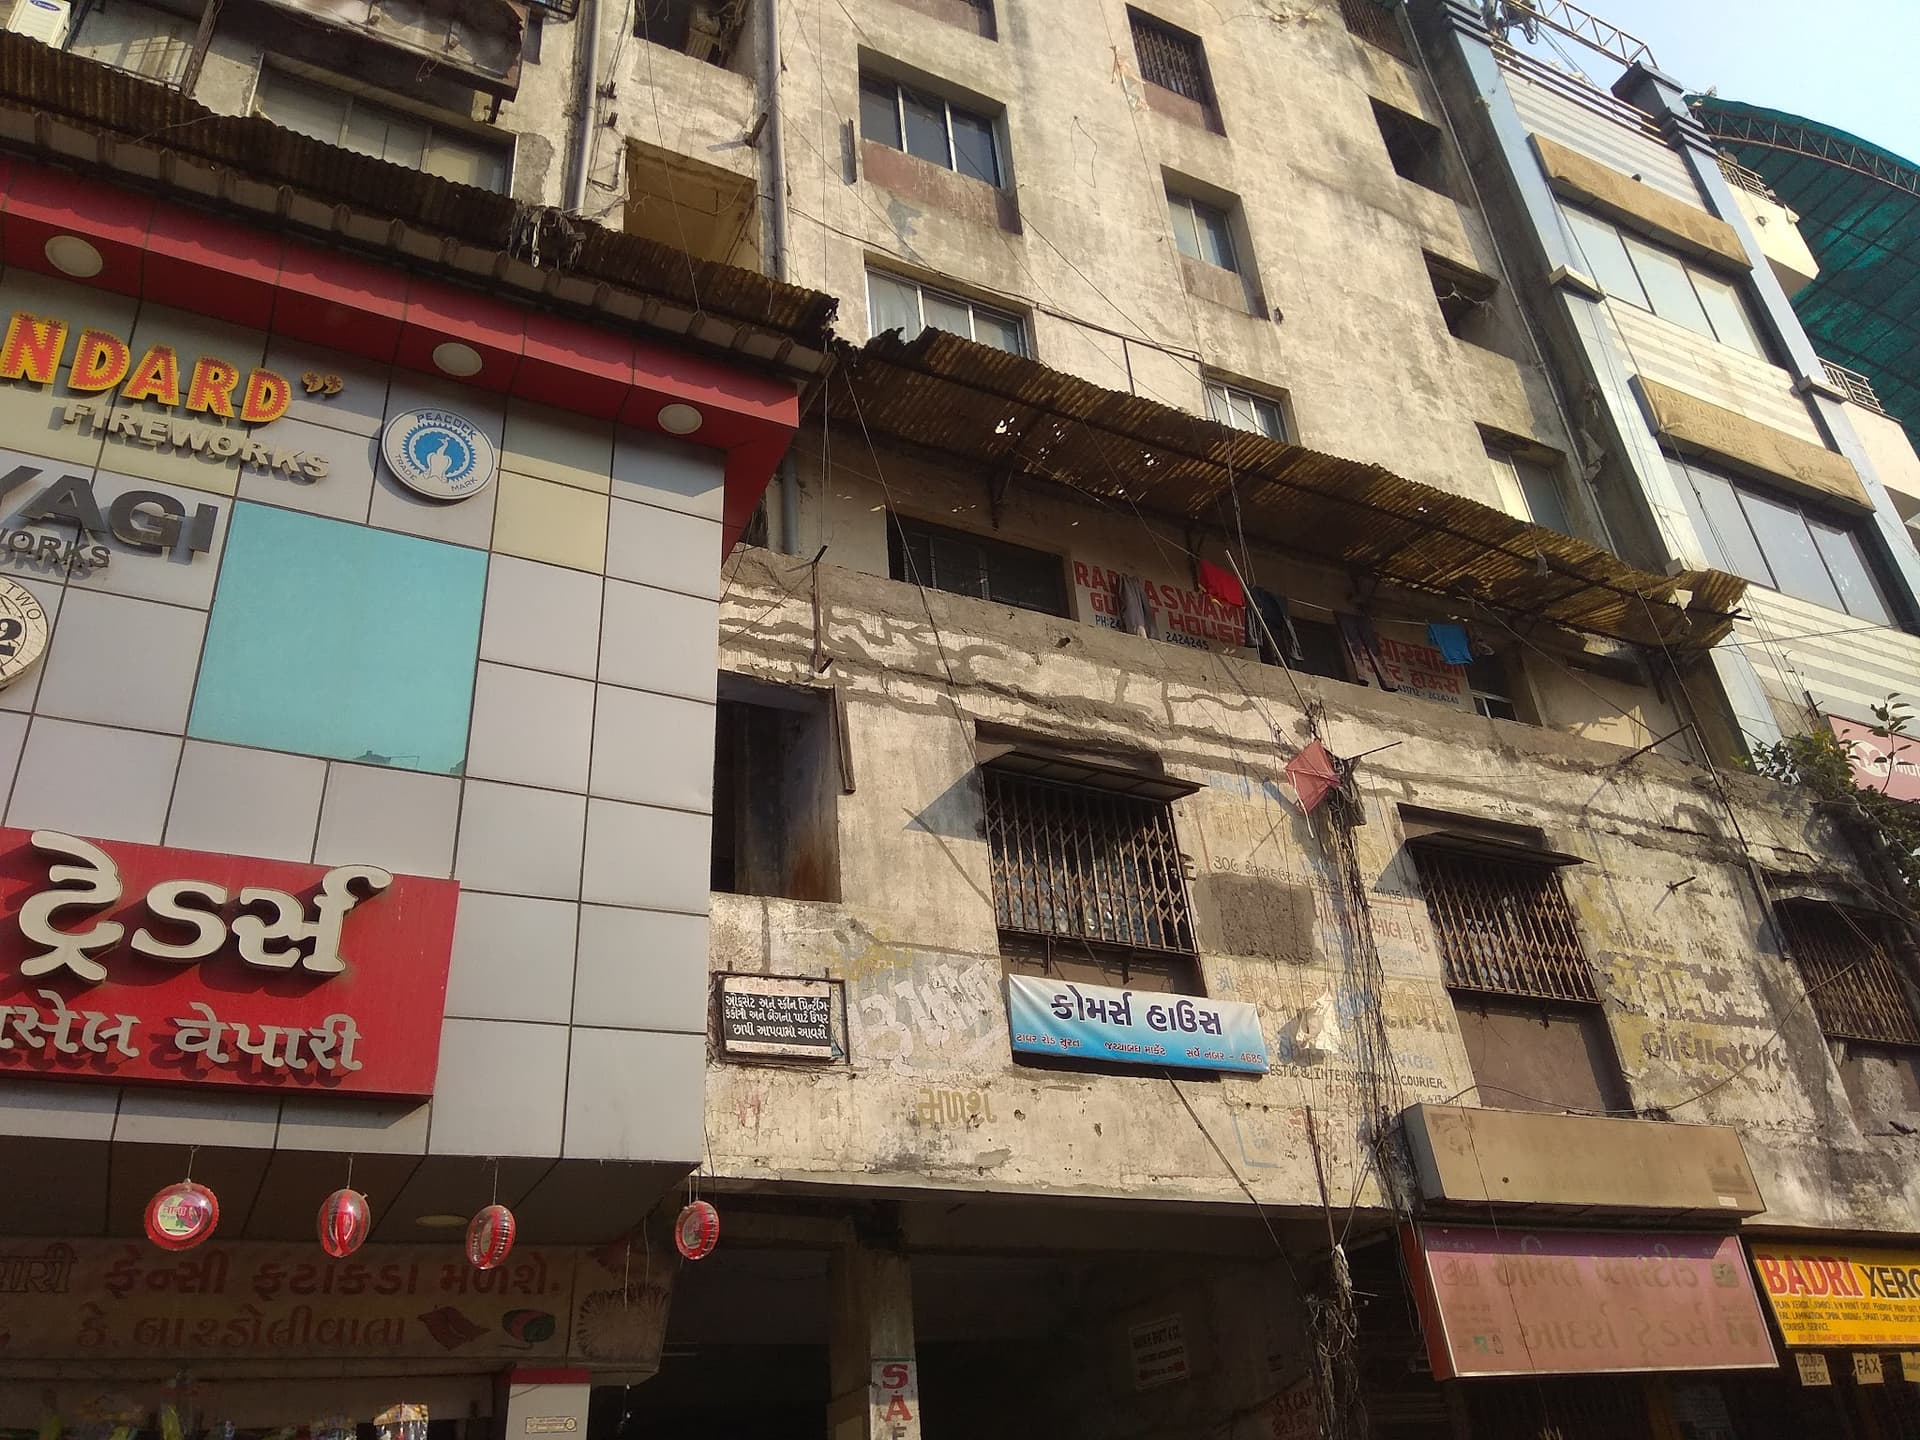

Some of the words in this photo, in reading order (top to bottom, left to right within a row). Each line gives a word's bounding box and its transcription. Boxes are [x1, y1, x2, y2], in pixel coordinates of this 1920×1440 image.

[63, 399, 329, 478] FIREWORKS
[417, 411, 478, 441] PEACOCK
[395, 453, 418, 481] TRADE
[450, 476, 478, 491] MARK
[6, 582, 42, 621] TWO
[1073, 559, 1246, 629] RADASWAMI
[1089, 591, 1160, 623] GUT
[1168, 614, 1246, 648] HOUSE
[18, 829, 394, 982] ટ્રેડર્સ
[748, 1007, 767, 1022] અને
[759, 996, 777, 1010] અને
[1050, 984, 1133, 1027] કોમર્સ
[1146, 1000, 1223, 1036] હાઉસ
[173, 1002, 364, 1072] વેપારી
[732, 1021, 755, 1036] છાપી
[797, 1024, 828, 1040] આવશે
[1016, 1032, 1037, 1043] ટાવર
[1041, 1032, 1056, 1045] રોડ
[1059, 1037, 1081, 1050] સુરત
[1144, 1043, 1167, 1056] માર્કેટ
[1204, 1047, 1225, 1061] નંબર
[1240, 1053, 1263, 1064] 4685
[103, 1245, 228, 1298] ફેન્સી
[251, 1259, 418, 1301] ફટાકડા
[1756, 1254, 1864, 1298] BADRI
[1857, 1357, 1880, 1376] FAX
